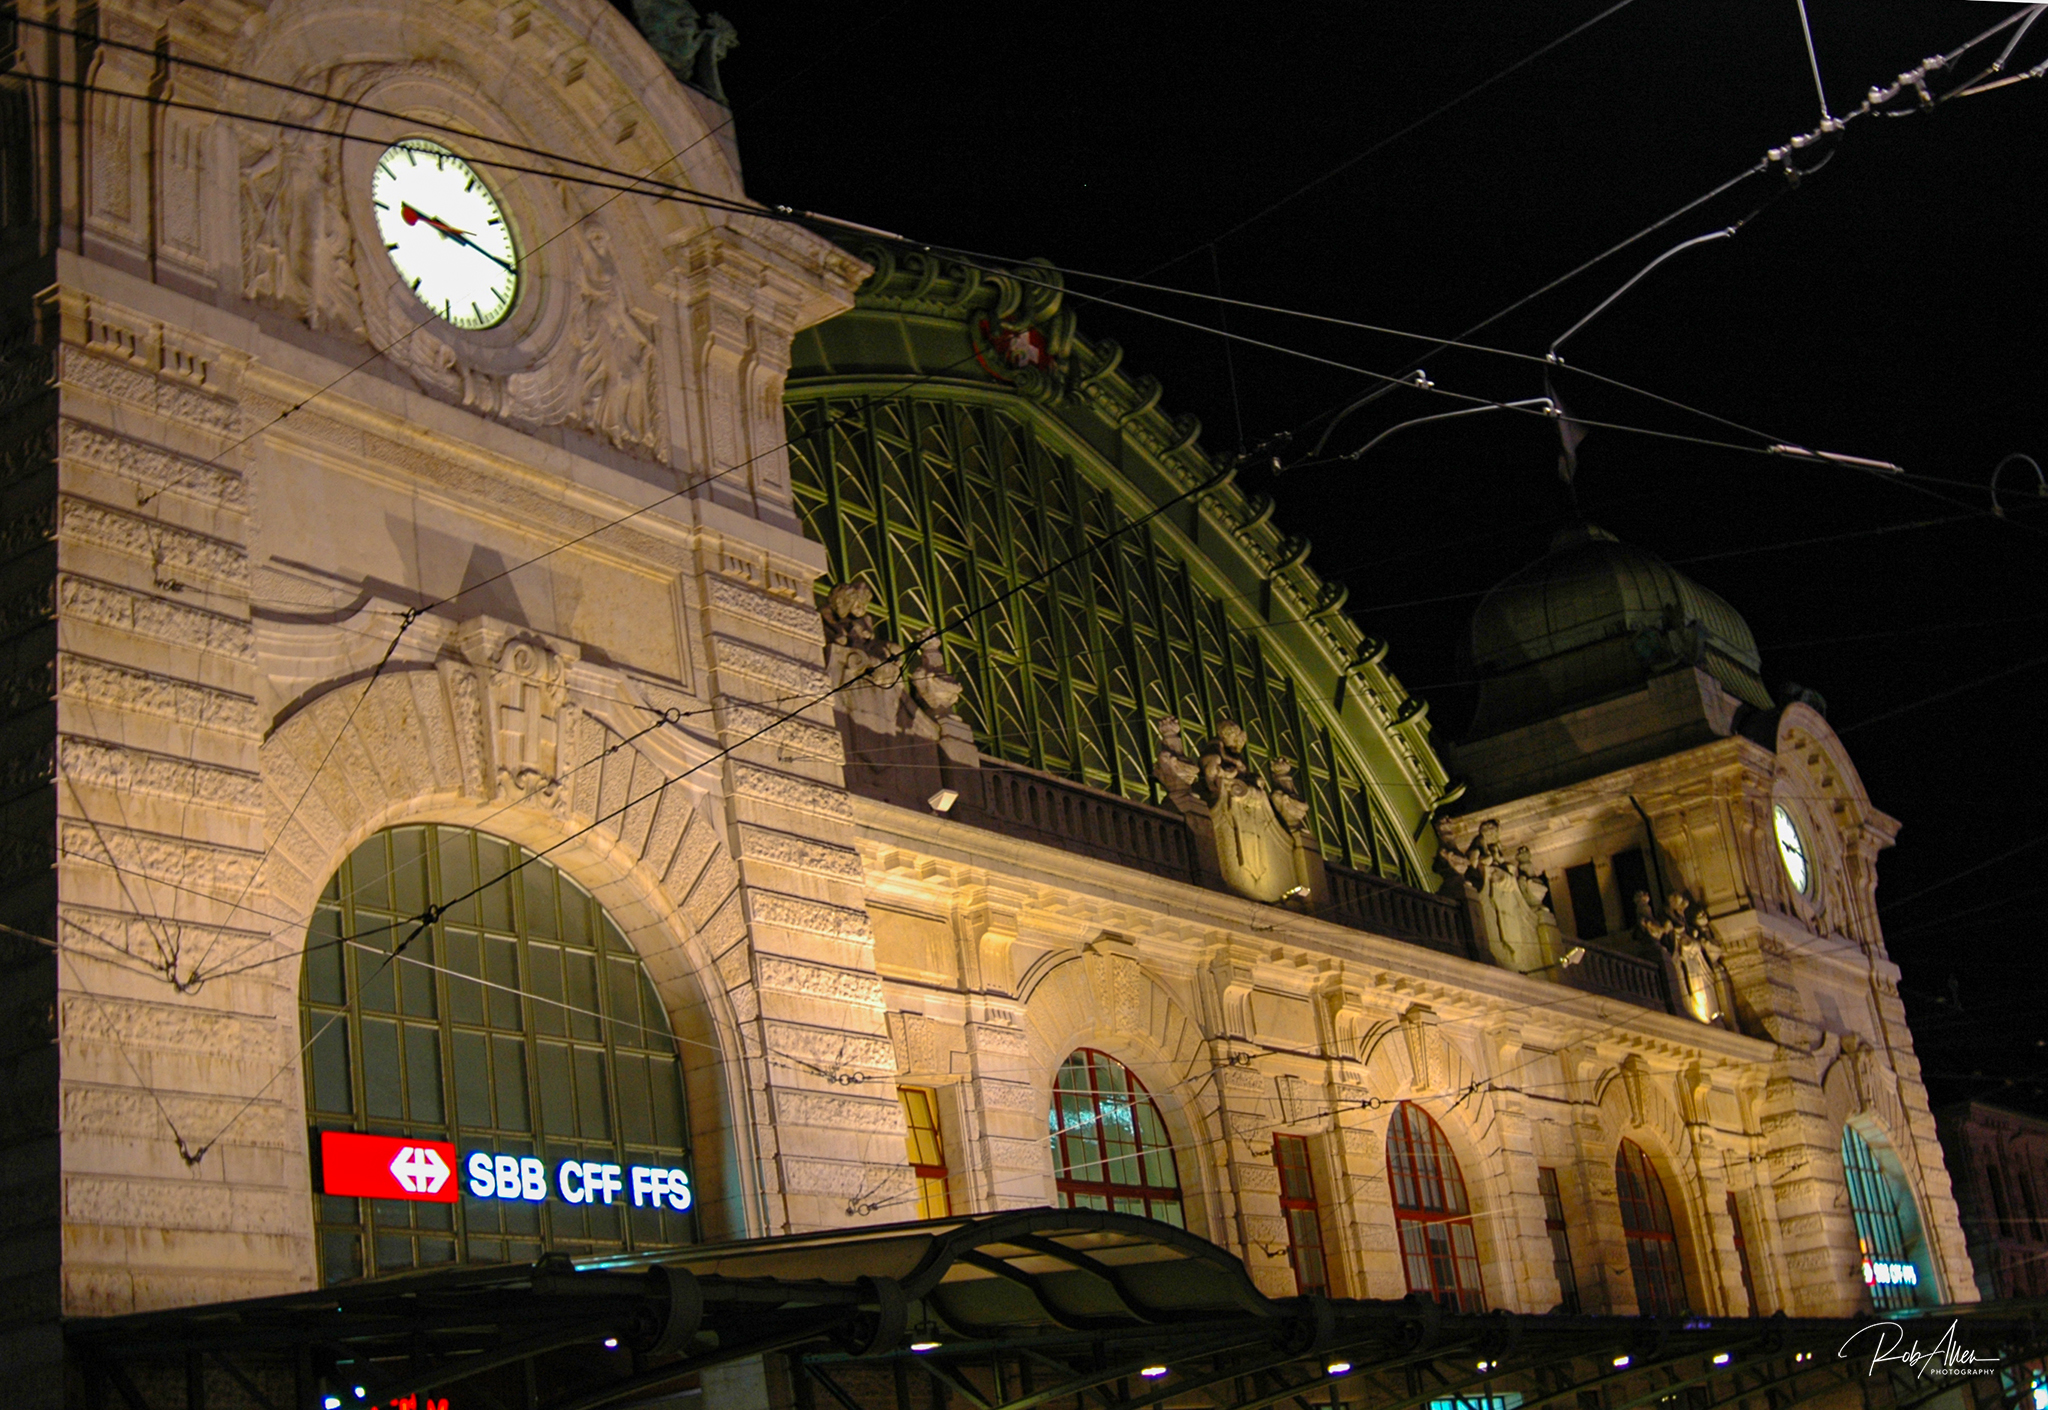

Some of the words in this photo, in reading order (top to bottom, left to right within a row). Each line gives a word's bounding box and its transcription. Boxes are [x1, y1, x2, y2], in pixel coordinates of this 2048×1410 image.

[468, 1153, 547, 1201] SBB
[559, 1160, 622, 1204] CFF
[631, 1166, 691, 1210] FFS
